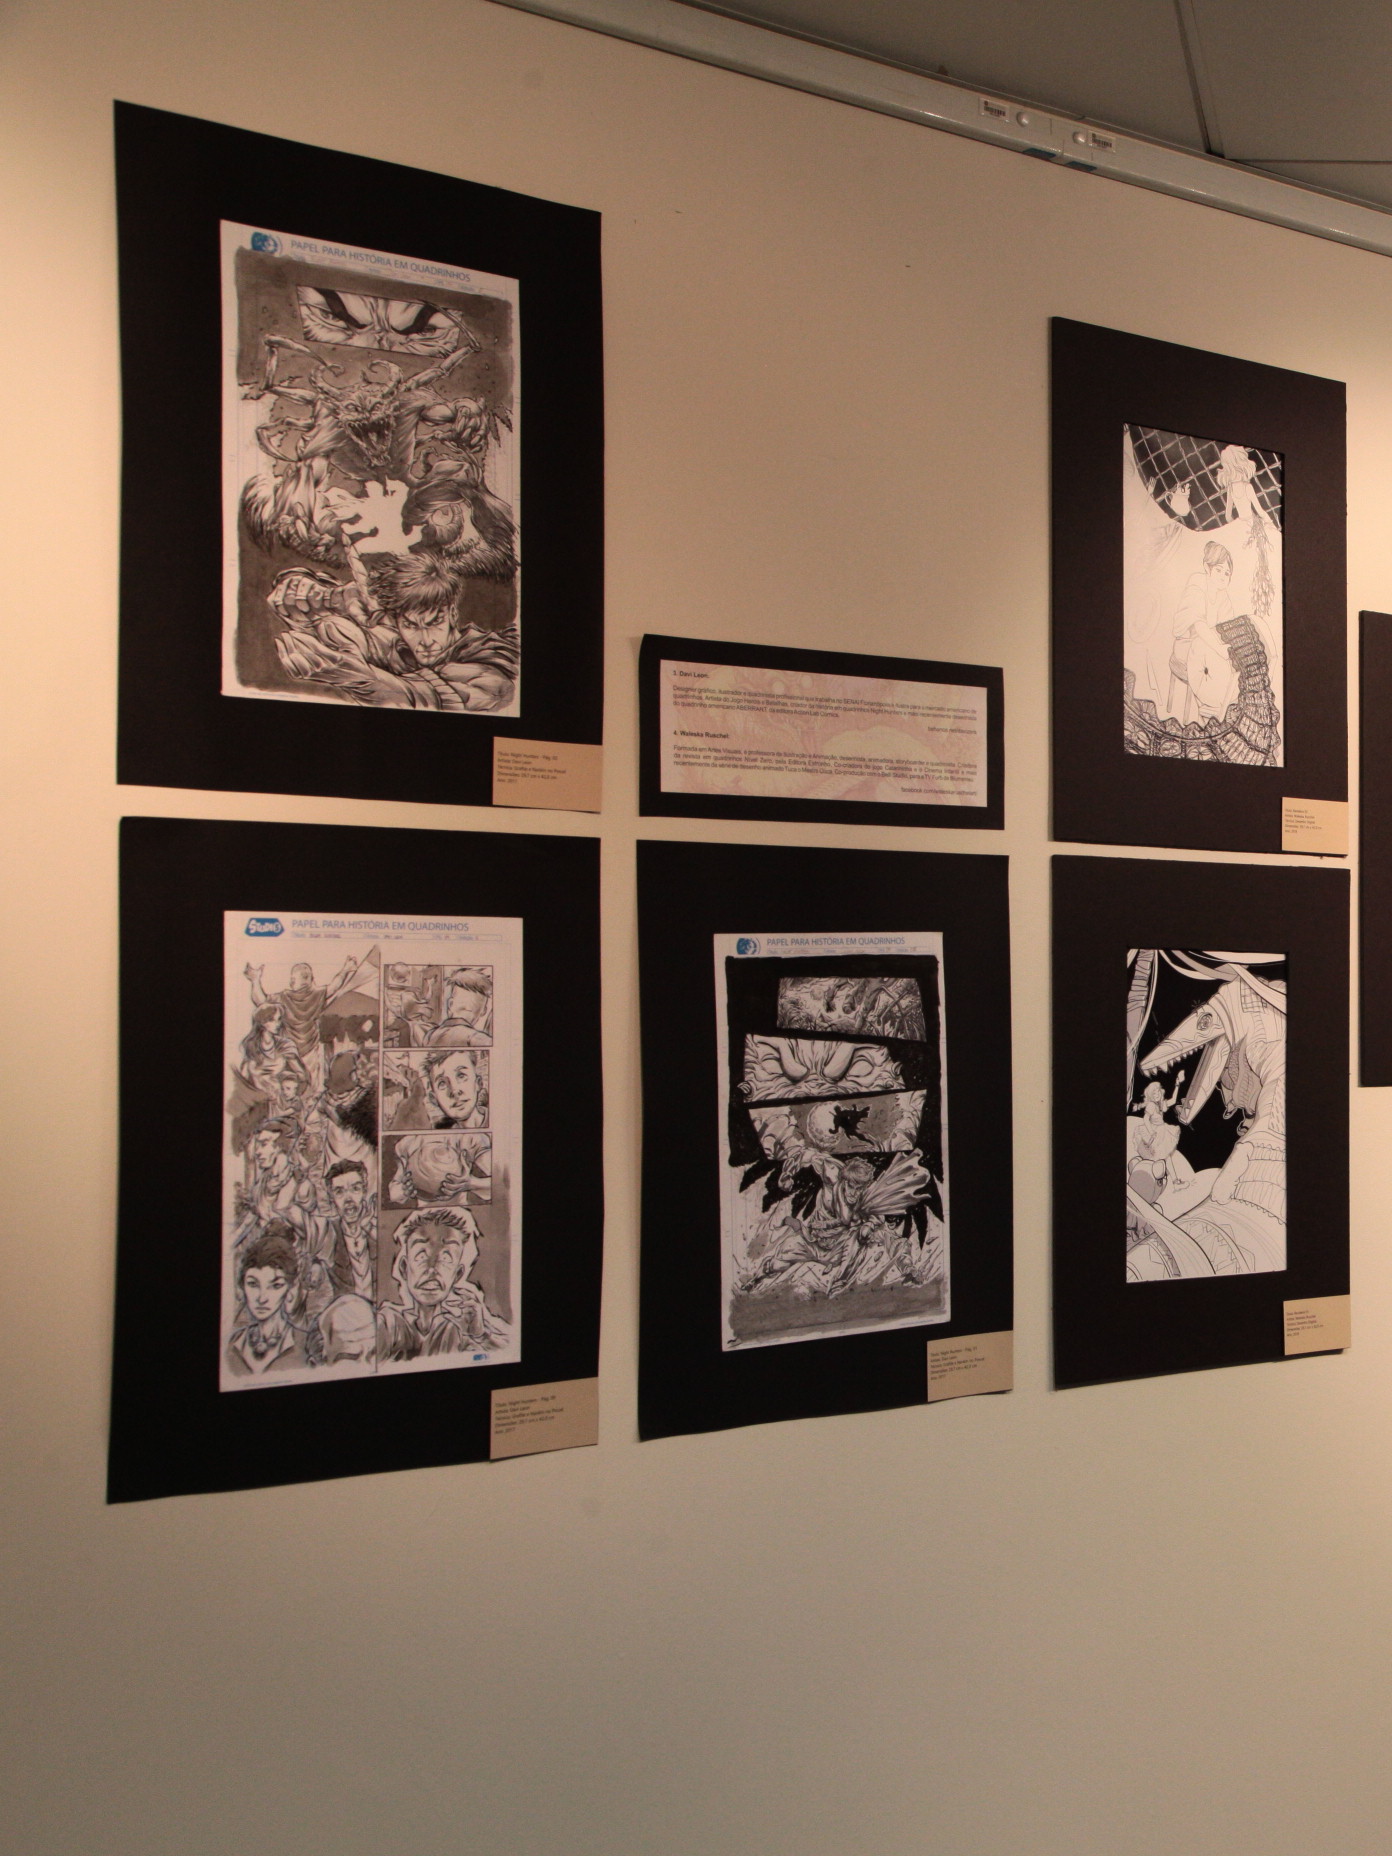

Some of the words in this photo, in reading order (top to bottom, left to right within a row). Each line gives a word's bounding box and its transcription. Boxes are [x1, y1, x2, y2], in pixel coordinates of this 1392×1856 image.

[290, 240, 319, 253] PAPEL
[322, 245, 346, 258] PARA
[349, 250, 392, 267] HISTÓRIA
[394, 261, 408, 269] EM
[410, 262, 470, 282] QUADRINHOS
[292, 919, 320, 929] PAPEL
[322, 920, 346, 930] PARA
[348, 919, 389, 930] HISTÓRIA
[392, 921, 406, 931] EM
[408, 921, 469, 932] QUADRINHOS
[812, 937, 844, 945] HISTÓRIA
[858, 937, 906, 945] QUADRINHOS
